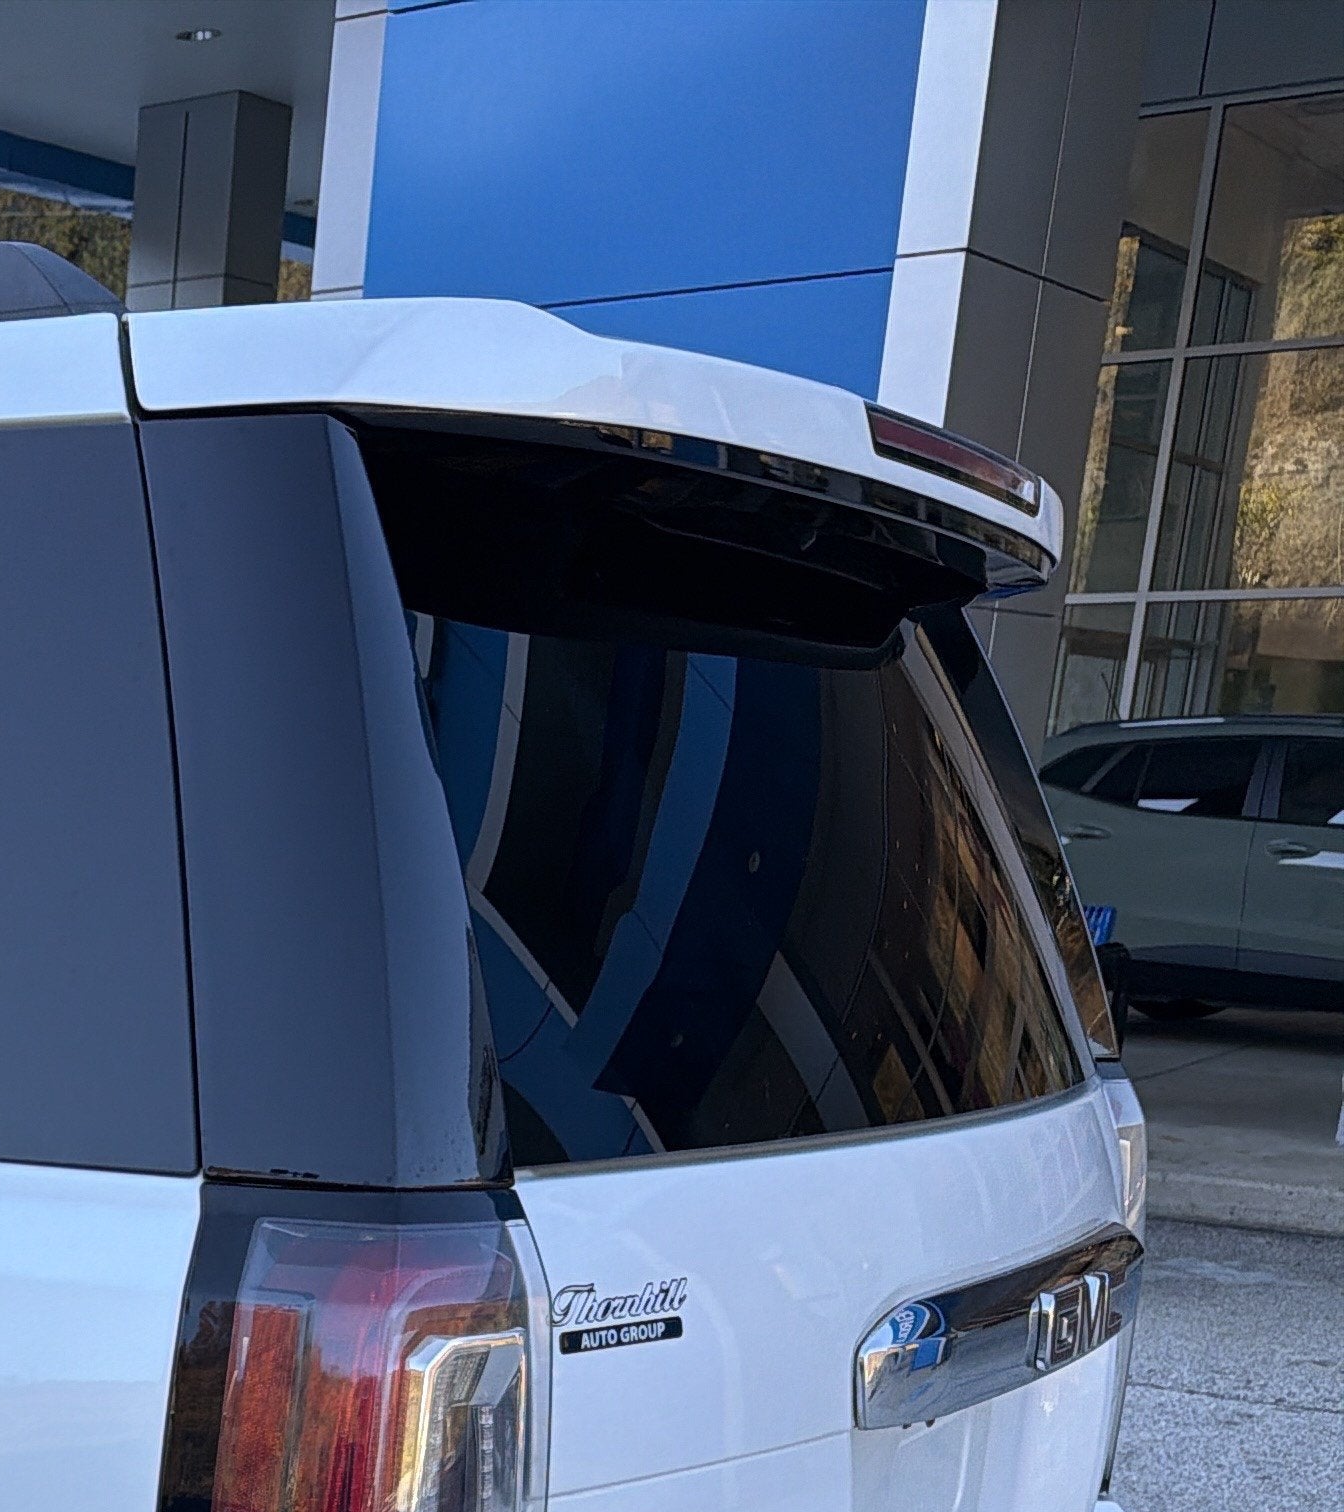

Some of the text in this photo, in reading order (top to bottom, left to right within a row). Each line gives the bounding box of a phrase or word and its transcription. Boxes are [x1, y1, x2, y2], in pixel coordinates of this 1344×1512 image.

[552, 1277, 688, 1327] Thornhill
[1027, 1269, 1122, 1372] GM
[581, 1321, 666, 1350] AUTO GROUP
